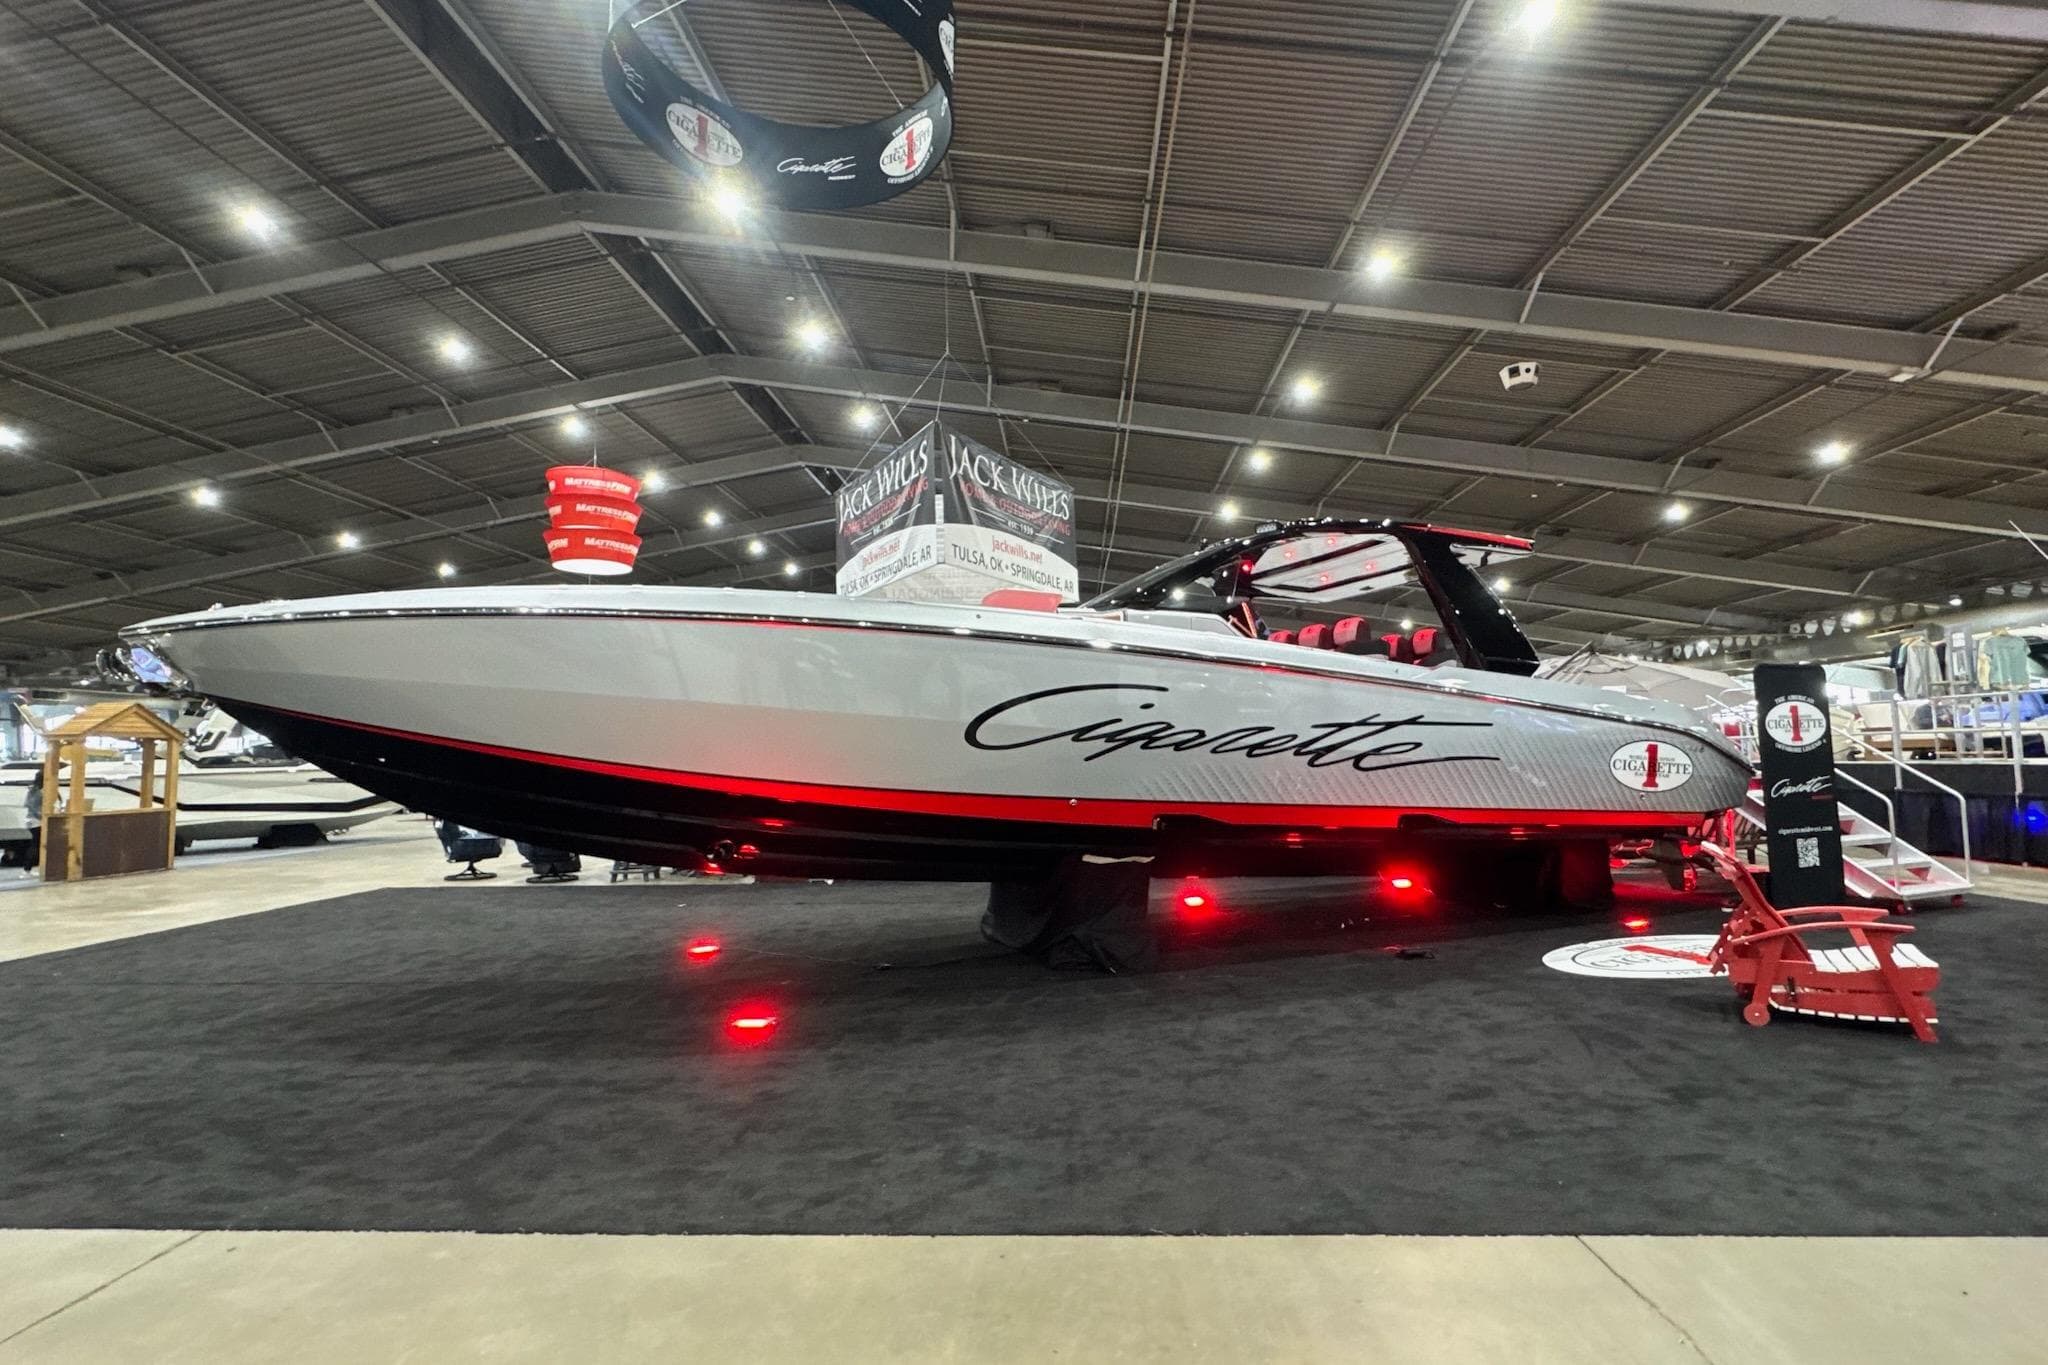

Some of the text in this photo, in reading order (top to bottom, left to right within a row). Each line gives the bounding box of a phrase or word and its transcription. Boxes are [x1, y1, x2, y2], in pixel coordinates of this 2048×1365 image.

[776, 155, 857, 175] Cigarette
[839, 439, 928, 534] JACK WILLS
[949, 434, 1072, 521] JACK WILLS
[862, 540, 900, 571] jackwills.net
[919, 544, 932, 562] AR
[992, 535, 1043, 564] jackwills.net
[952, 543, 1074, 592] TULSA, OK SPRINGDALE, AR
[963, 683, 1501, 771] Cigarette
[1770, 775, 1833, 798] Cigarette
